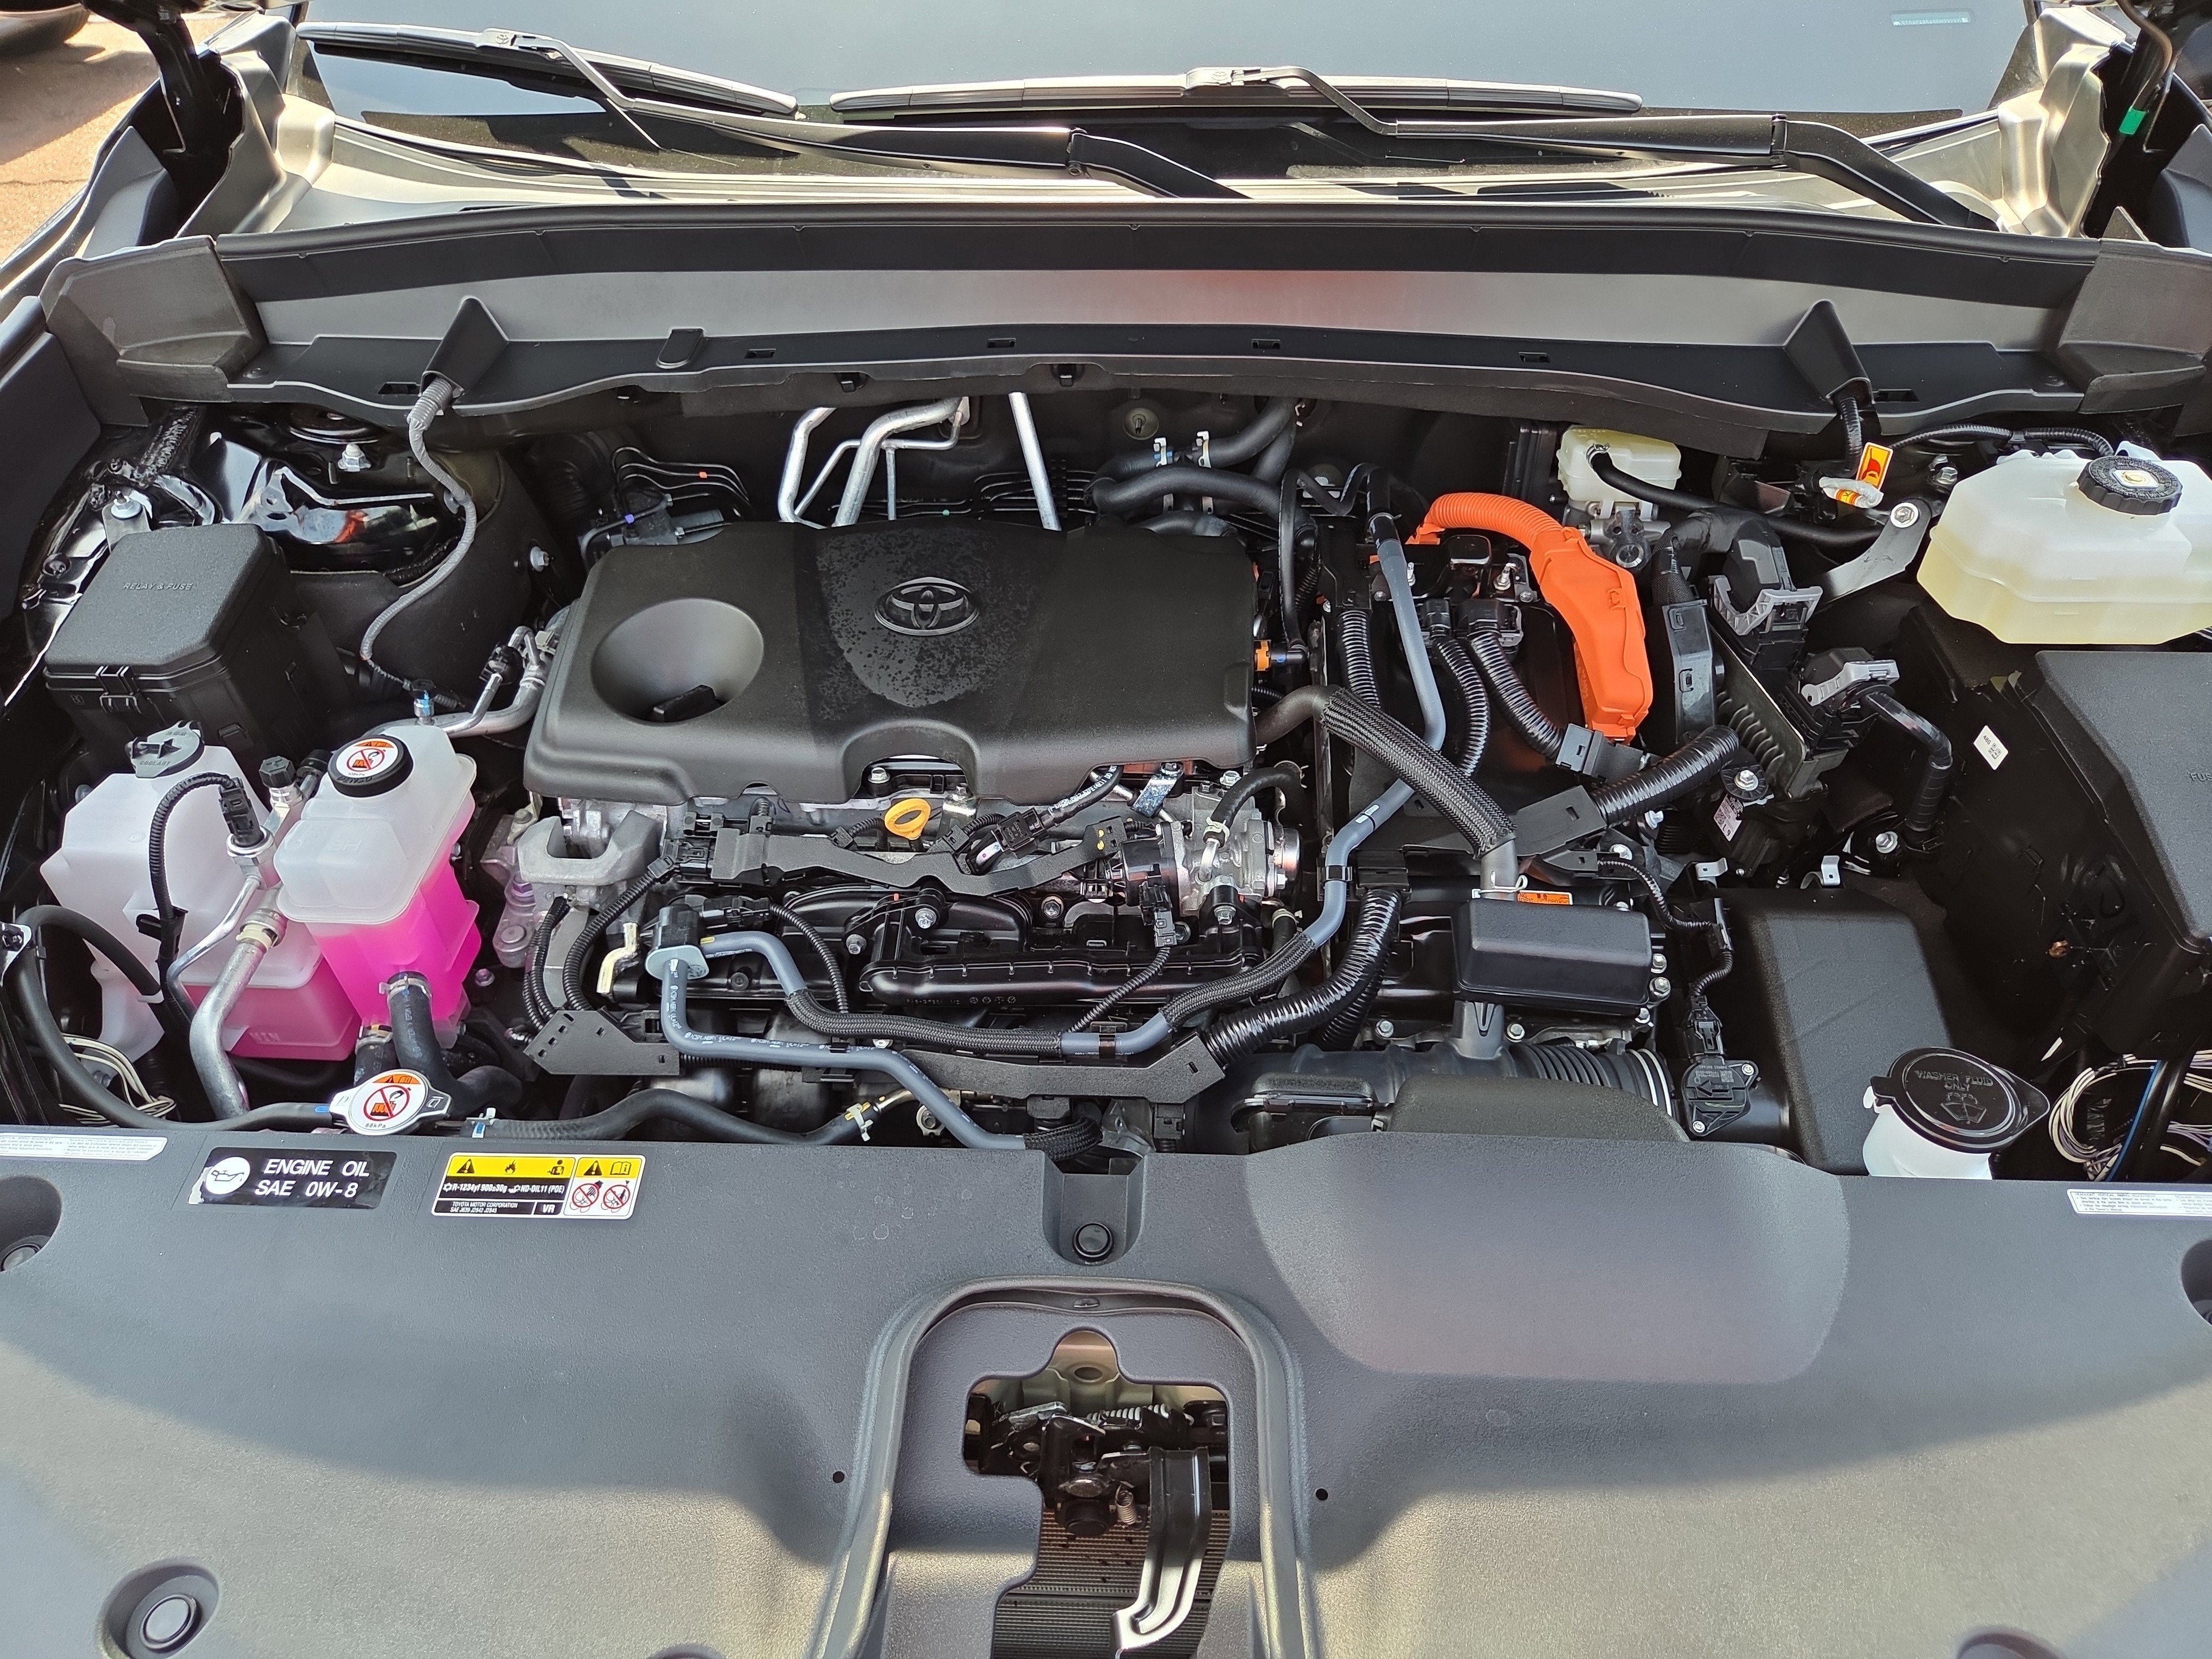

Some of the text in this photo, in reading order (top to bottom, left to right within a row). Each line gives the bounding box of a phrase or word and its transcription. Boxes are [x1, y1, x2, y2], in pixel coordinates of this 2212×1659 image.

[123, 582, 194, 591] RELAY & FUSE
[1914, 1070, 1994, 1087] WASHER FLUID
[1944, 1082, 1970, 1092] ONLY
[263, 1159, 370, 1177] ENGINE OIL
[255, 1179, 359, 1198] SAE 0W-8
[548, 1185, 565, 1194] (POE)
[542, 1204, 556, 1214] VR
